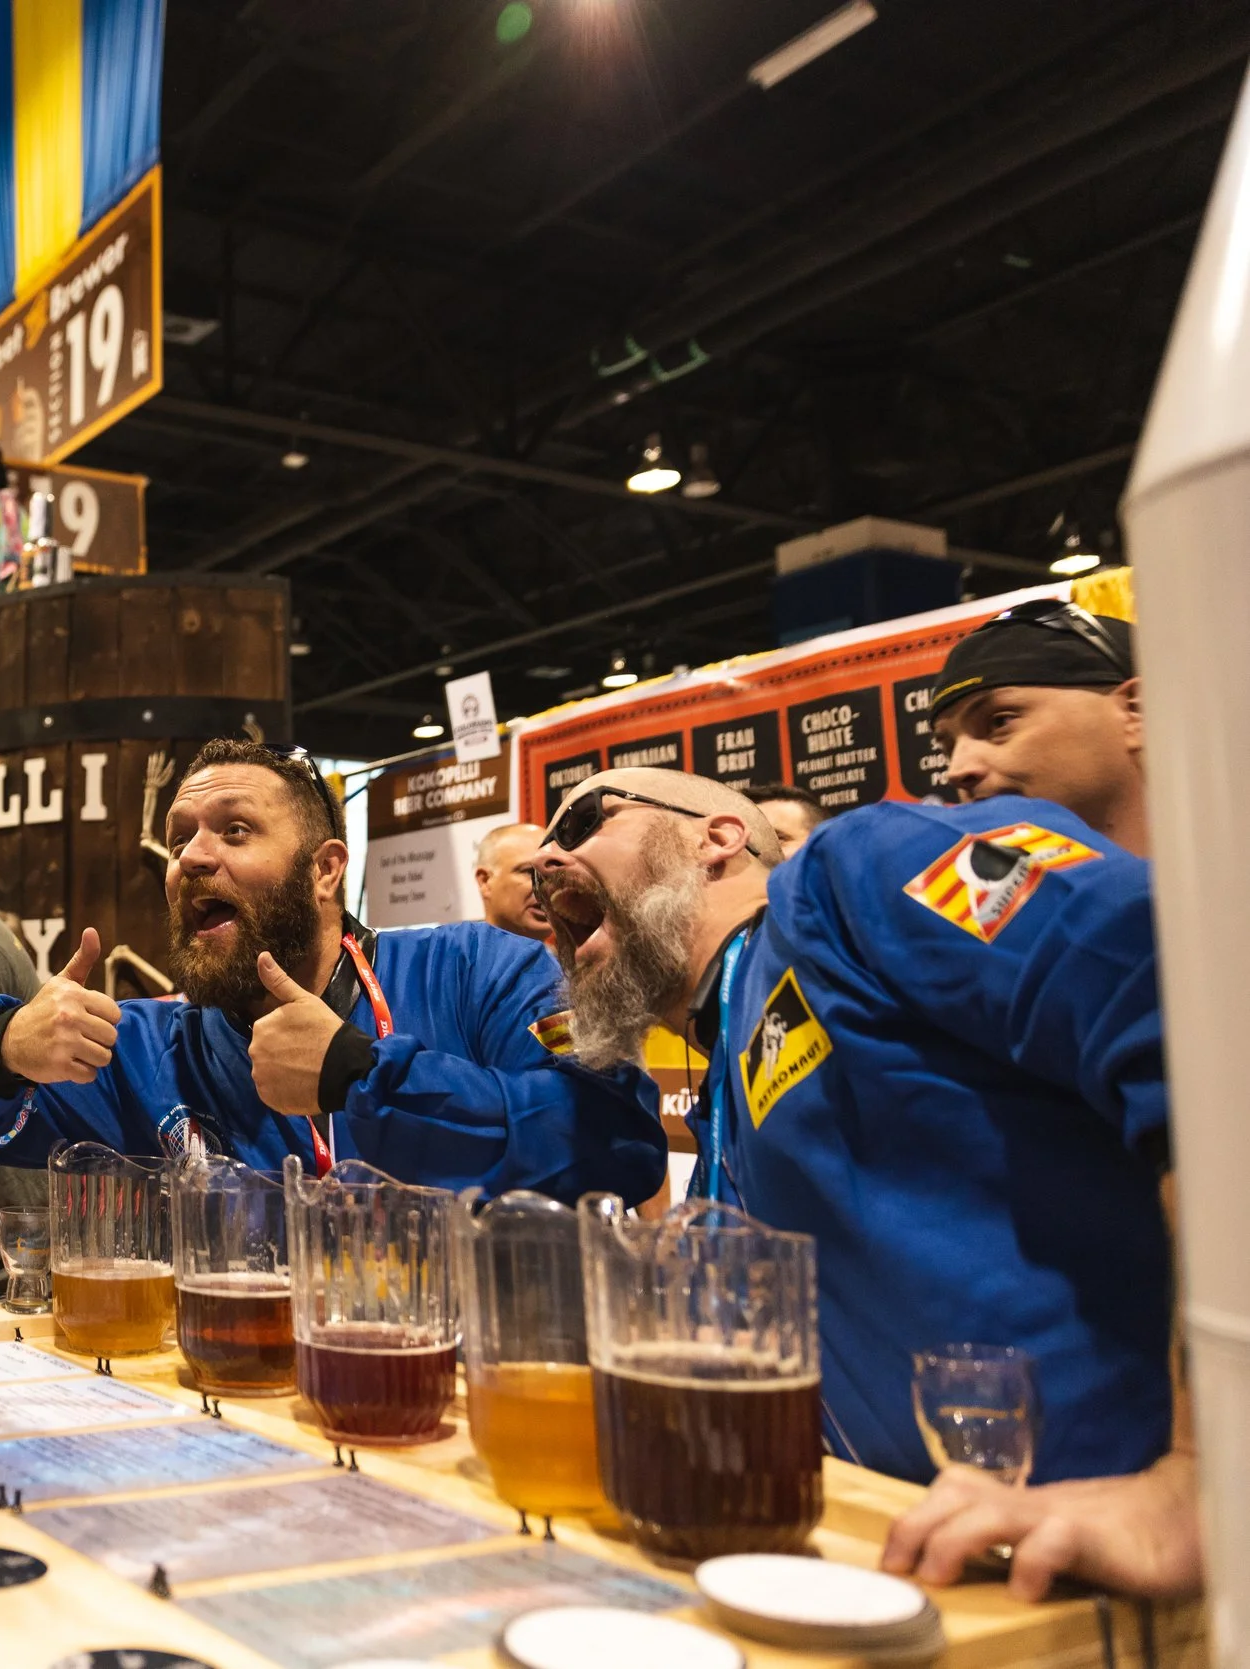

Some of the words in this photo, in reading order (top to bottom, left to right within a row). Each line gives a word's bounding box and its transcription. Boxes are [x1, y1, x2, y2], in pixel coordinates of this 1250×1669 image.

[66, 284, 125, 428] 19
[801, 704, 861, 735] CHOCO-
[425, 775, 498, 809] COMPANY
[809, 767, 867, 791] CHOCOLATE
[361, 967, 381, 1002] Dickies
